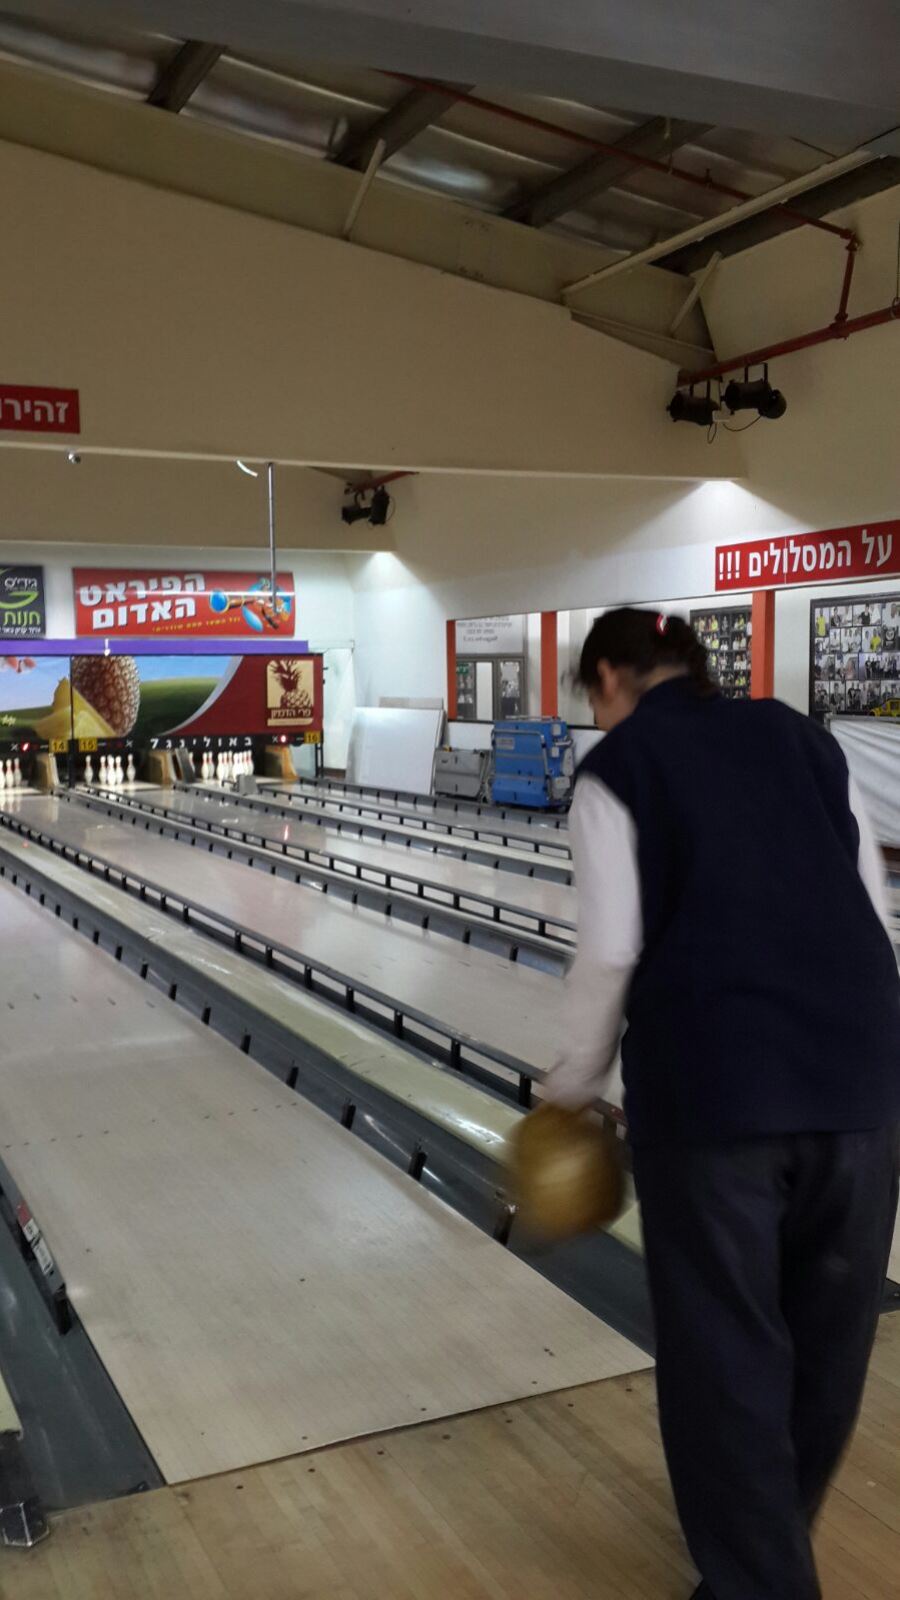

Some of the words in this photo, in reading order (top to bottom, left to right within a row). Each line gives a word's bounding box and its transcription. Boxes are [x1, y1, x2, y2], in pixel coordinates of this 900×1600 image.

[0, 398, 69, 424] זהיר
[748, 539, 852, 578] המסלולים
[862, 529, 893, 567] על
[79, 573, 206, 607] הפיראט
[3, 611, 41, 627] חנות
[92, 596, 196, 631] האדום
